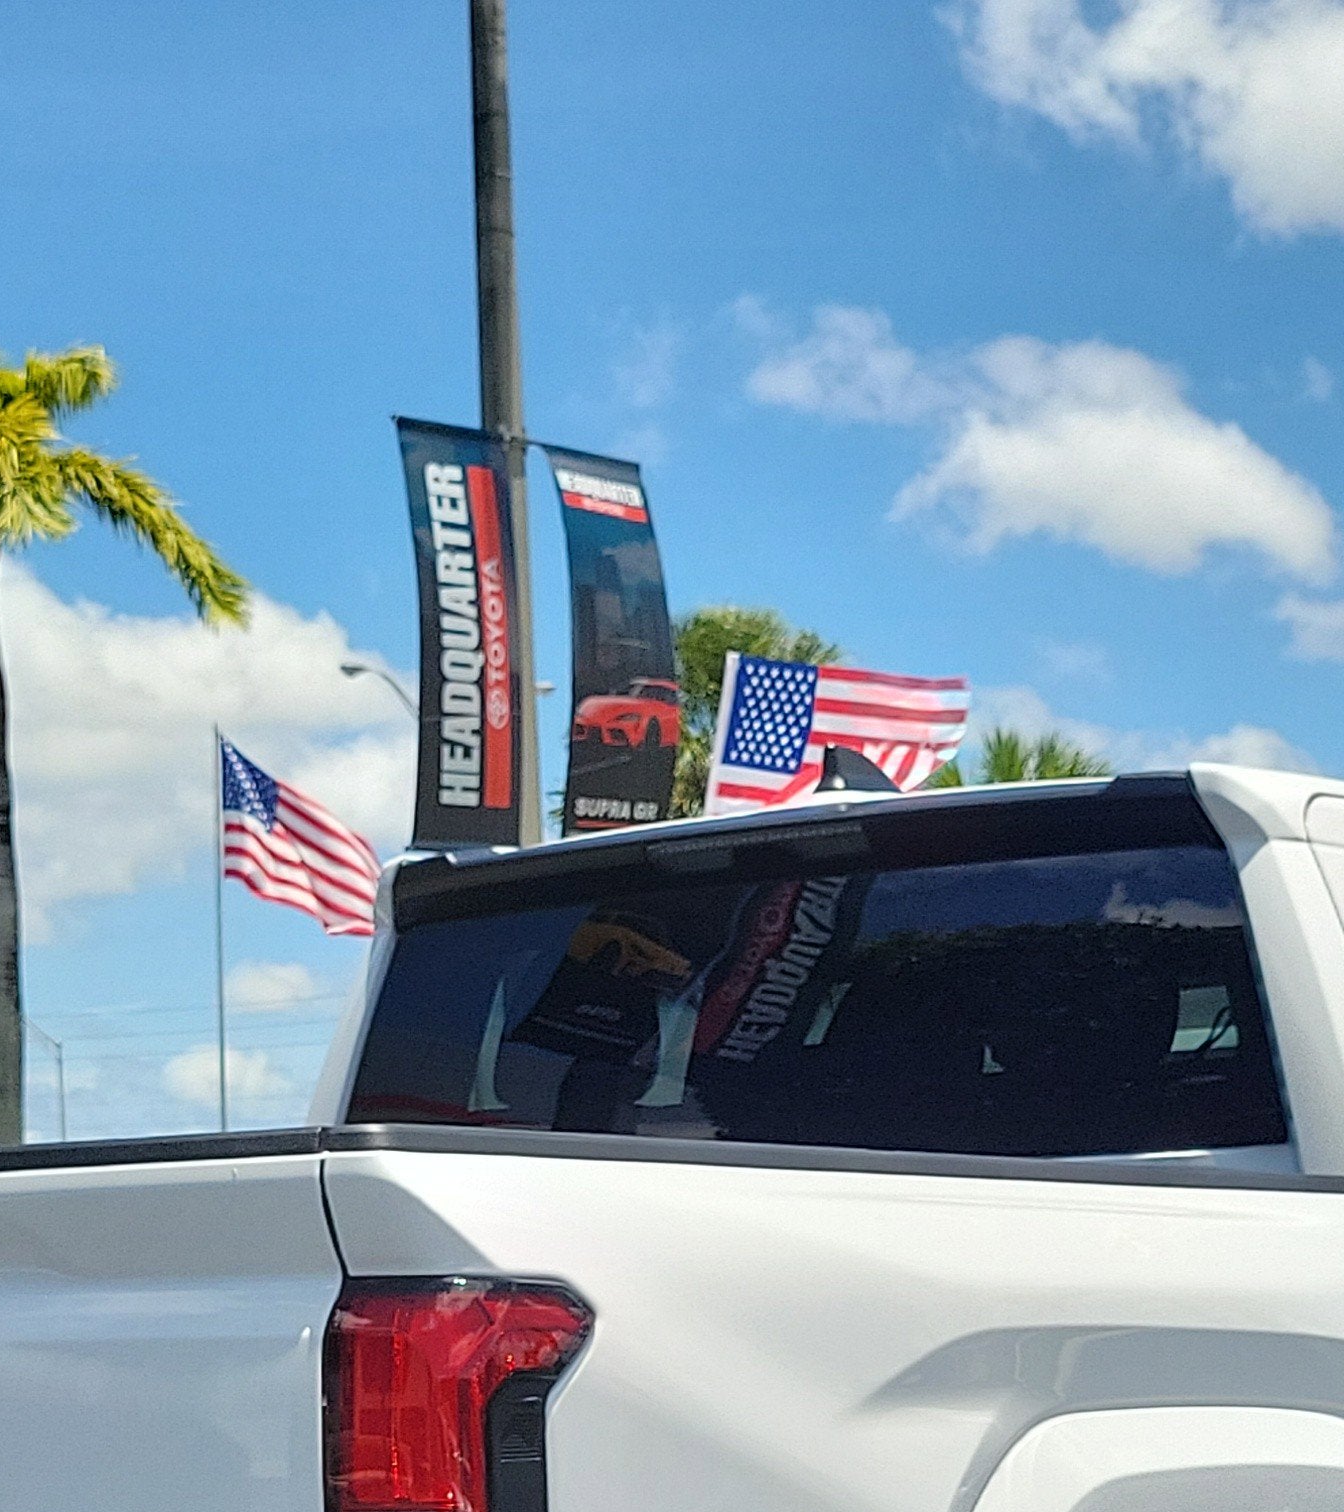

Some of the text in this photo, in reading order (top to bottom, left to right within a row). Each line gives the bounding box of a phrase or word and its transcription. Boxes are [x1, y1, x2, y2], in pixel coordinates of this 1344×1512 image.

[424, 462, 485, 808] HEADQUARTER
[482, 559, 507, 683] TOYOTA
[574, 796, 632, 820] SUPRA
